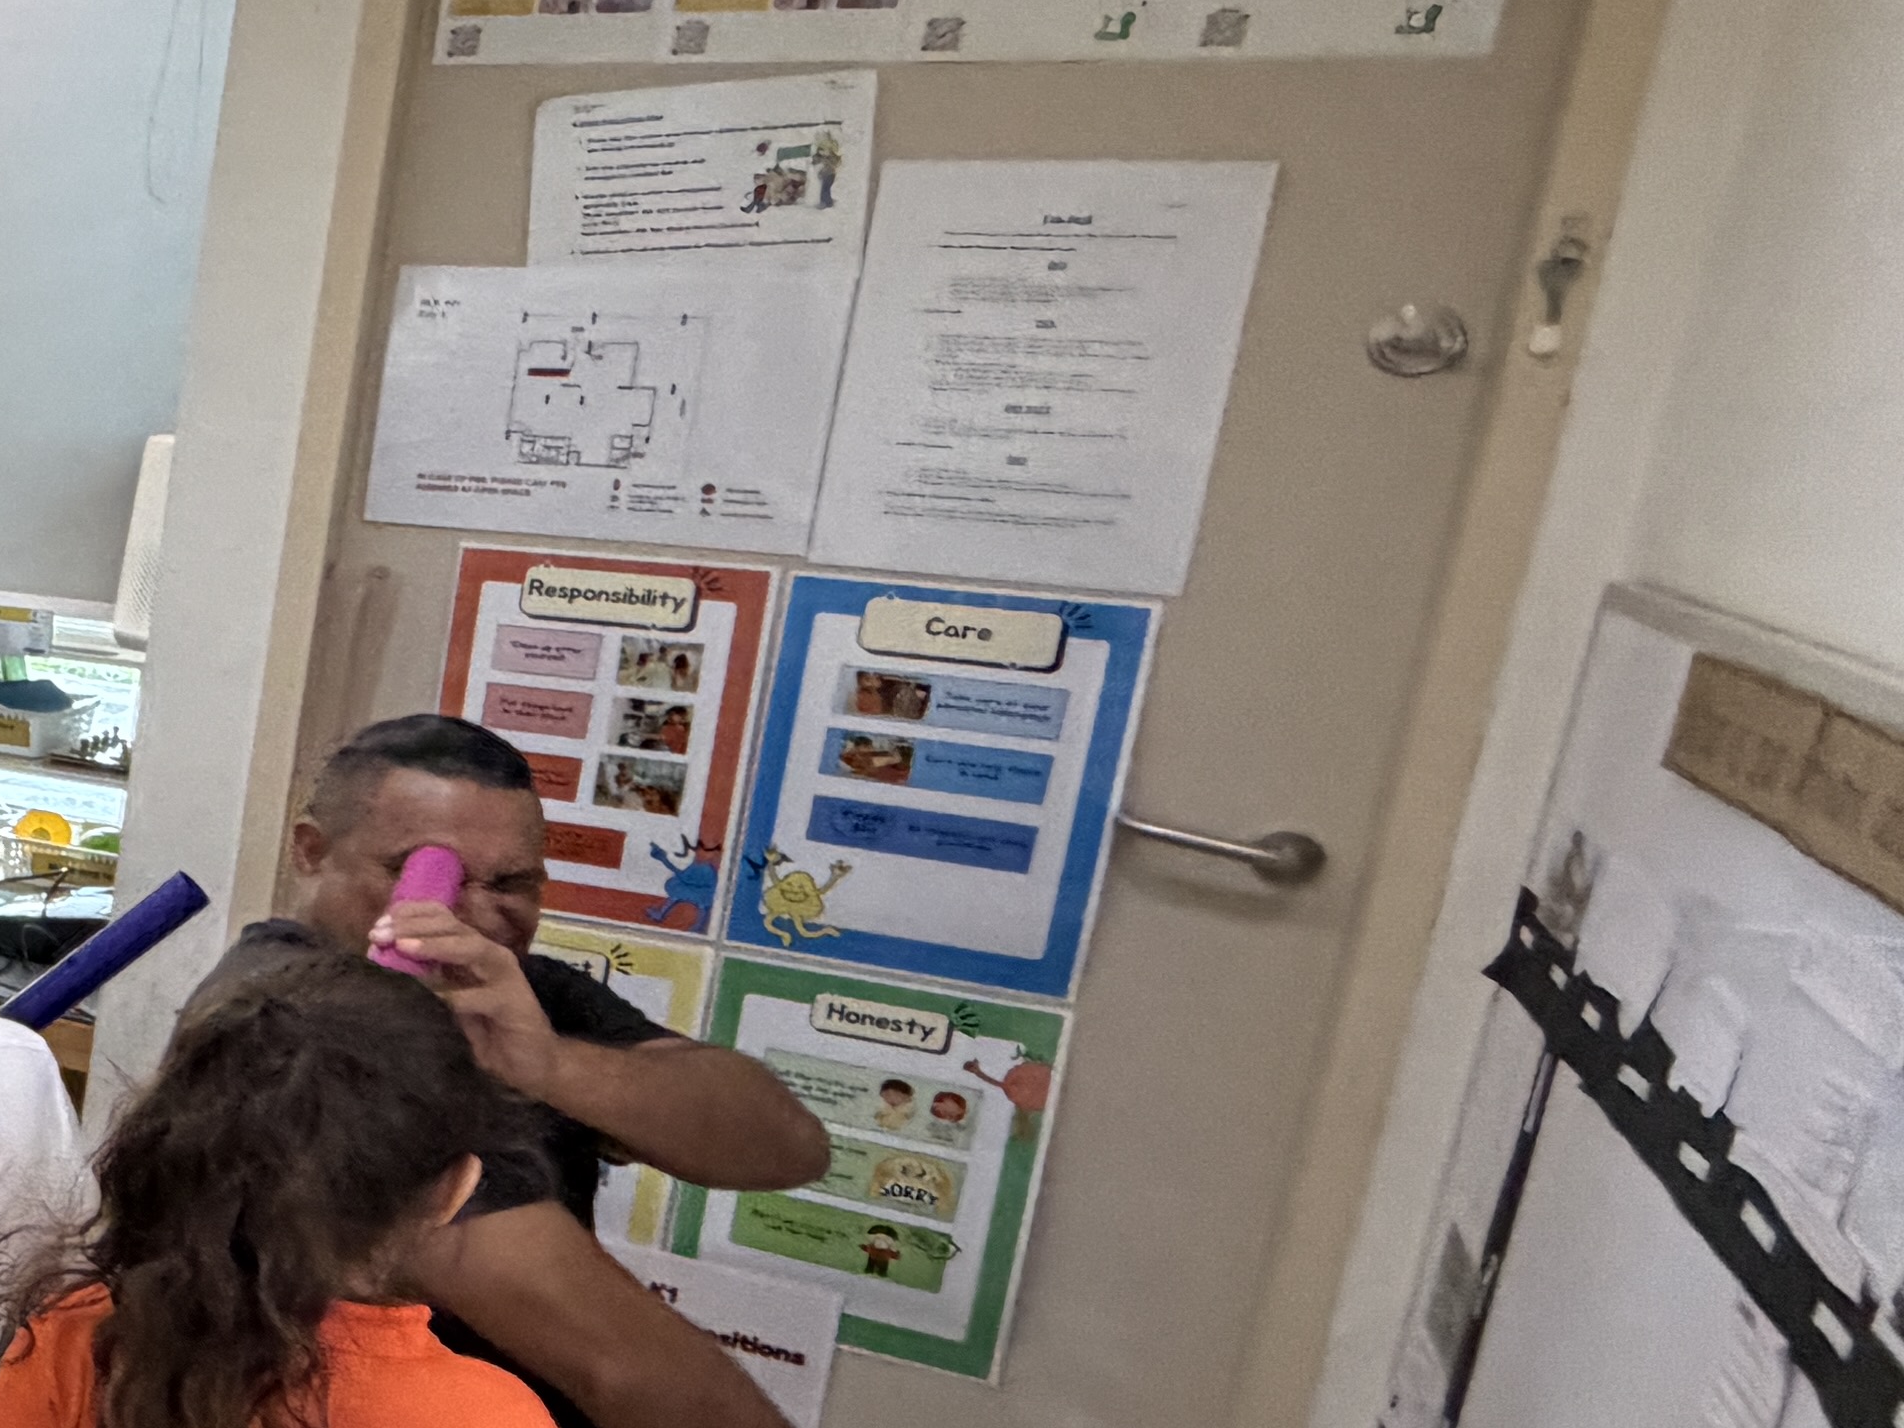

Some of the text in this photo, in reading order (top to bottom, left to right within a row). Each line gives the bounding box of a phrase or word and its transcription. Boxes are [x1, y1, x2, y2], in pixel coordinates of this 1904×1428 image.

[528, 578, 687, 613] Responsibility
[925, 616, 993, 641] Care
[827, 1003, 937, 1042] Honesty
[880, 1183, 938, 1205] SORRY
